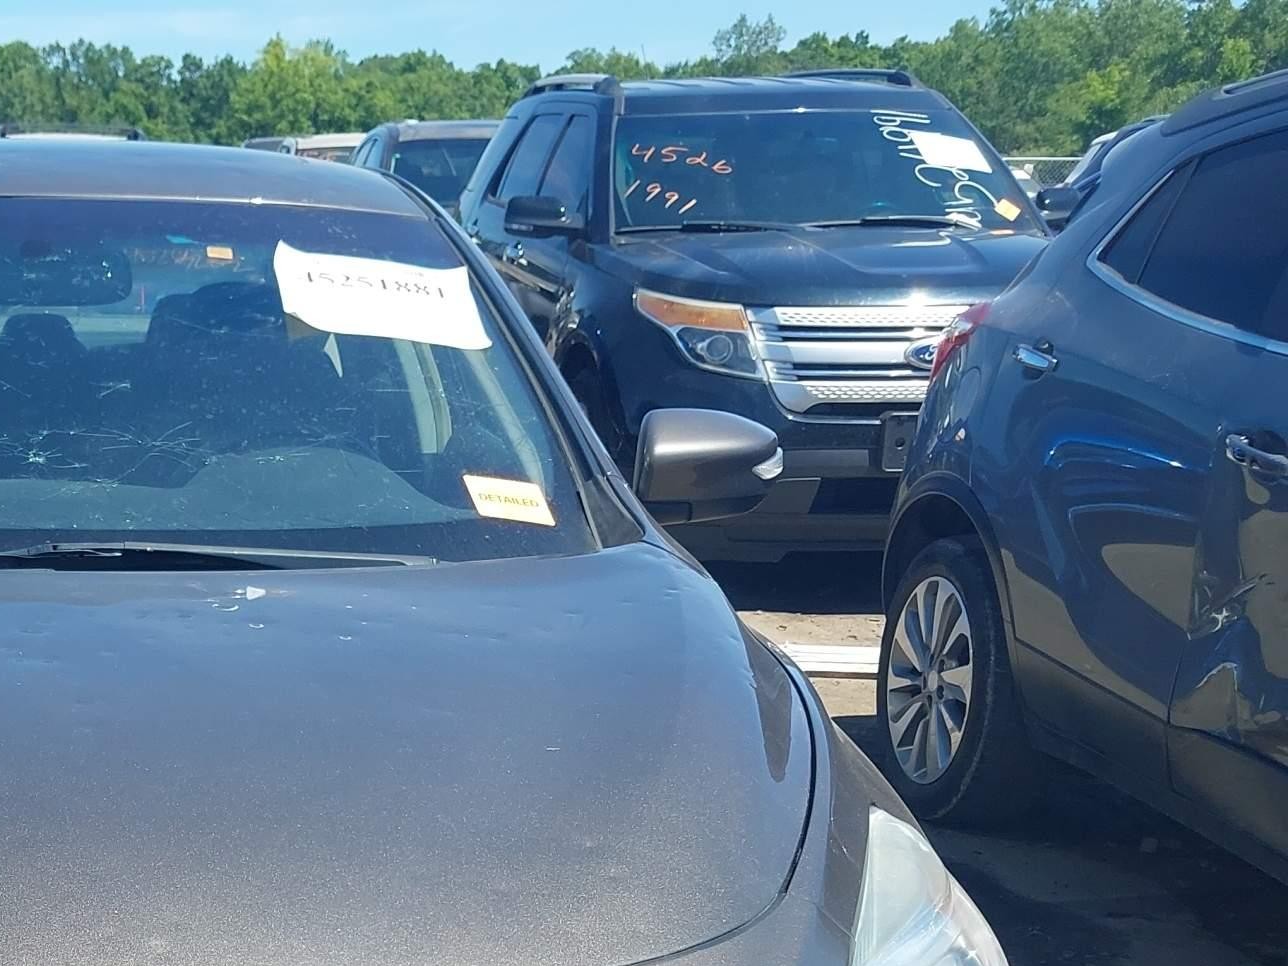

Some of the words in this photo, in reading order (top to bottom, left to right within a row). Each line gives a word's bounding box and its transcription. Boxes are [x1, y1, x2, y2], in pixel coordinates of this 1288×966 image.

[632, 143, 733, 174] 4526
[623, 179, 697, 214] 1991
[478, 492, 540, 508] DETAILED
